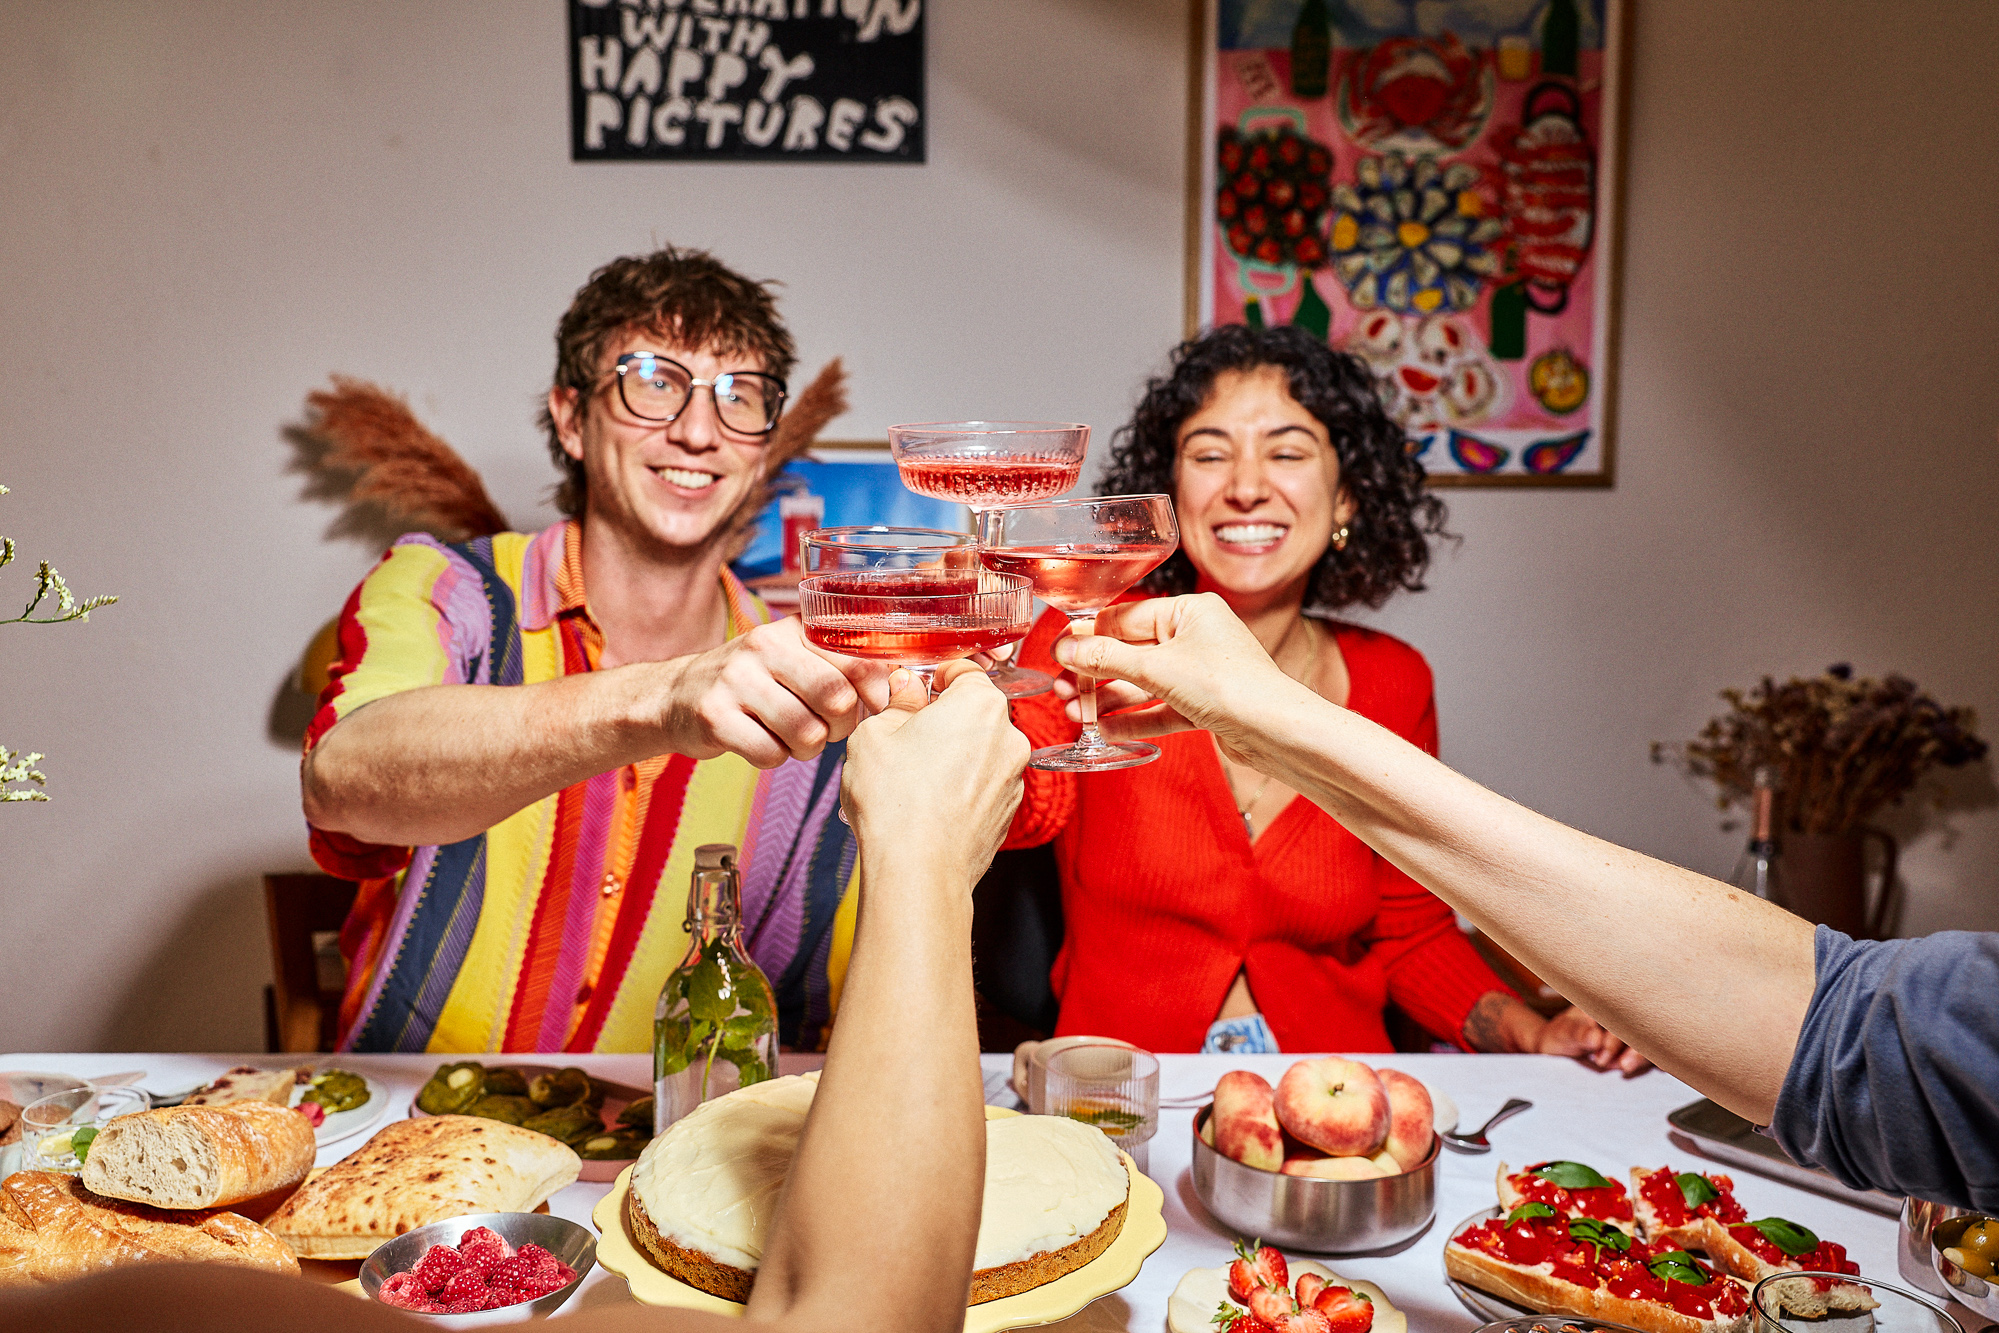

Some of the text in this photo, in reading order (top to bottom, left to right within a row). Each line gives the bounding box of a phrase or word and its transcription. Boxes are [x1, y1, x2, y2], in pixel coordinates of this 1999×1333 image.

[620, 7, 771, 57] WITH
[579, 35, 815, 102] HAPPY
[584, 92, 919, 151] PICTURES
